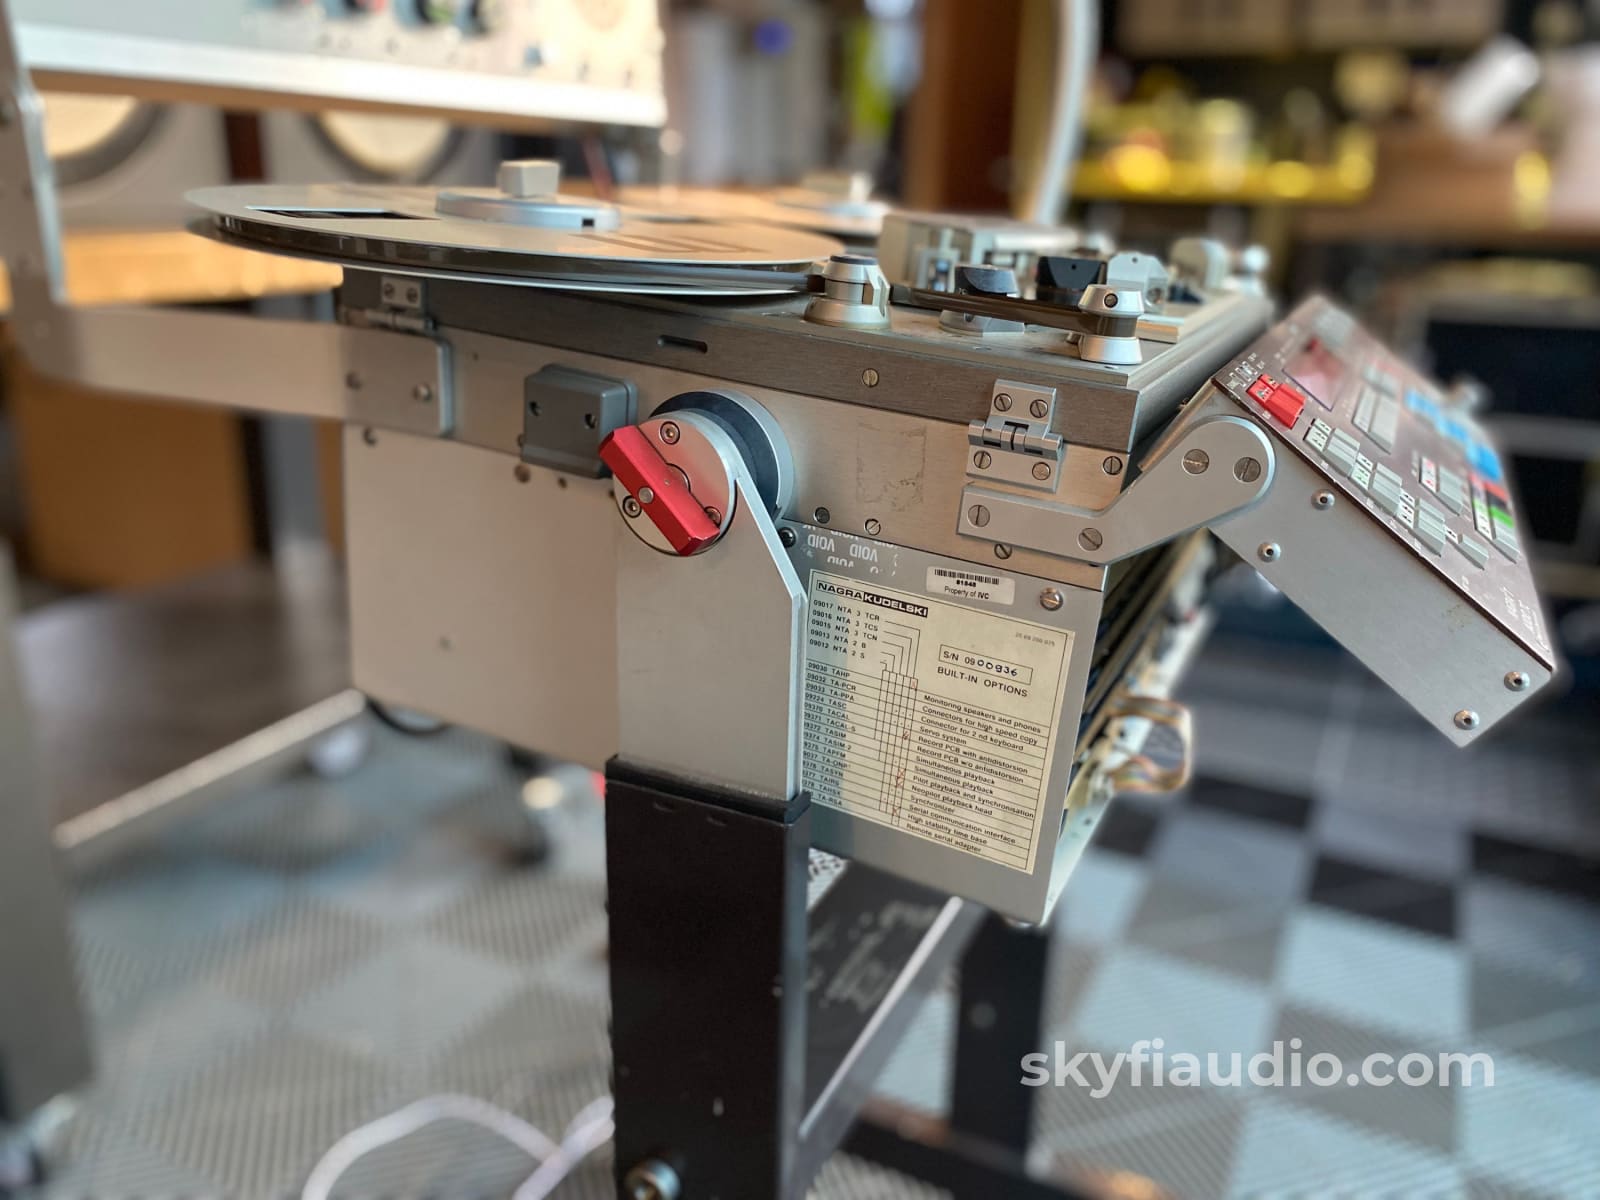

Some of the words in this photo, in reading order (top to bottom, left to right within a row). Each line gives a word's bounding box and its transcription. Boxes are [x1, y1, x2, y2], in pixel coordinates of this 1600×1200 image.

[807, 534, 835, 553] VOID
[849, 543, 878, 563] VOID
[818, 582, 863, 600] NAGRA
[864, 594, 927, 617] KUDELSKI
[944, 585, 969, 598] Property
[977, 591, 990, 600] IVC
[813, 609, 832, 620] 09016
[836, 615, 851, 625] NTA
[864, 623, 878, 632] TCS
[814, 599, 833, 610] 09017
[838, 605, 852, 615] NTA
[866, 612, 880, 622] TCR
[811, 629, 830, 640] 09013
[834, 635, 849, 645] NTA
[812, 619, 831, 630] 09015
[835, 625, 850, 634] NTA
[863, 632, 878, 642] TCN
[810, 639, 829, 650] 09012
[833, 645, 847, 654] NTA
[944, 650, 959, 662] S/N
[937, 666, 978, 685] BUILT-IN
[983, 679, 1028, 698] OPTIONS
[922, 705, 963, 723] Connectors
[965, 718, 976, 727] for
[977, 721, 994, 733] high
[996, 726, 1018, 740] speed
[1020, 733, 1038, 746] copy
[924, 695, 962, 712] Monitoring
[964, 706, 997, 722] speakers
[998, 716, 1012, 725] and
[1014, 720, 1041, 734] phones
[920, 726, 940, 737] Servo
[942, 732, 967, 746] system
[921, 716, 957, 731] Connector
[959, 727, 970, 735] for
[990, 736, 1024, 752] keyboard
[917, 746, 941, 759] Record
[943, 754, 959, 764] PCB
[975, 763, 1024, 784] antidistorsion
[919, 736, 943, 749] Record
[944, 744, 961, 754] PCB
[962, 749, 977, 759] with
[979, 754, 1028, 774] antidistorsion
[914, 765, 961, 785] Simultaneous
[962, 780, 994, 796] playback
[916, 756, 962, 775] Simultaneous
[964, 770, 996, 787] playback
[911, 794, 955, 815] Synchronizer
[912, 785, 940, 800] Neopilot
[942, 794, 974, 811] playback
[975, 805, 993, 816] head
[913, 775, 928, 785] Pilot
[930, 780, 961, 796] playback
[963, 791, 976, 800] and
[978, 795, 1035, 819] synchronisation
[907, 823, 930, 836] Remote
[933, 831, 952, 843] serial
[953, 838, 982, 854] adapter
[908, 813, 922, 824] High
[925, 819, 951, 834] stability
[953, 828, 969, 839] time
[970, 834, 987, 845] base
[909, 804, 929, 816] Serial
[931, 811, 983, 834] communication
[984, 828, 1016, 844] interface
